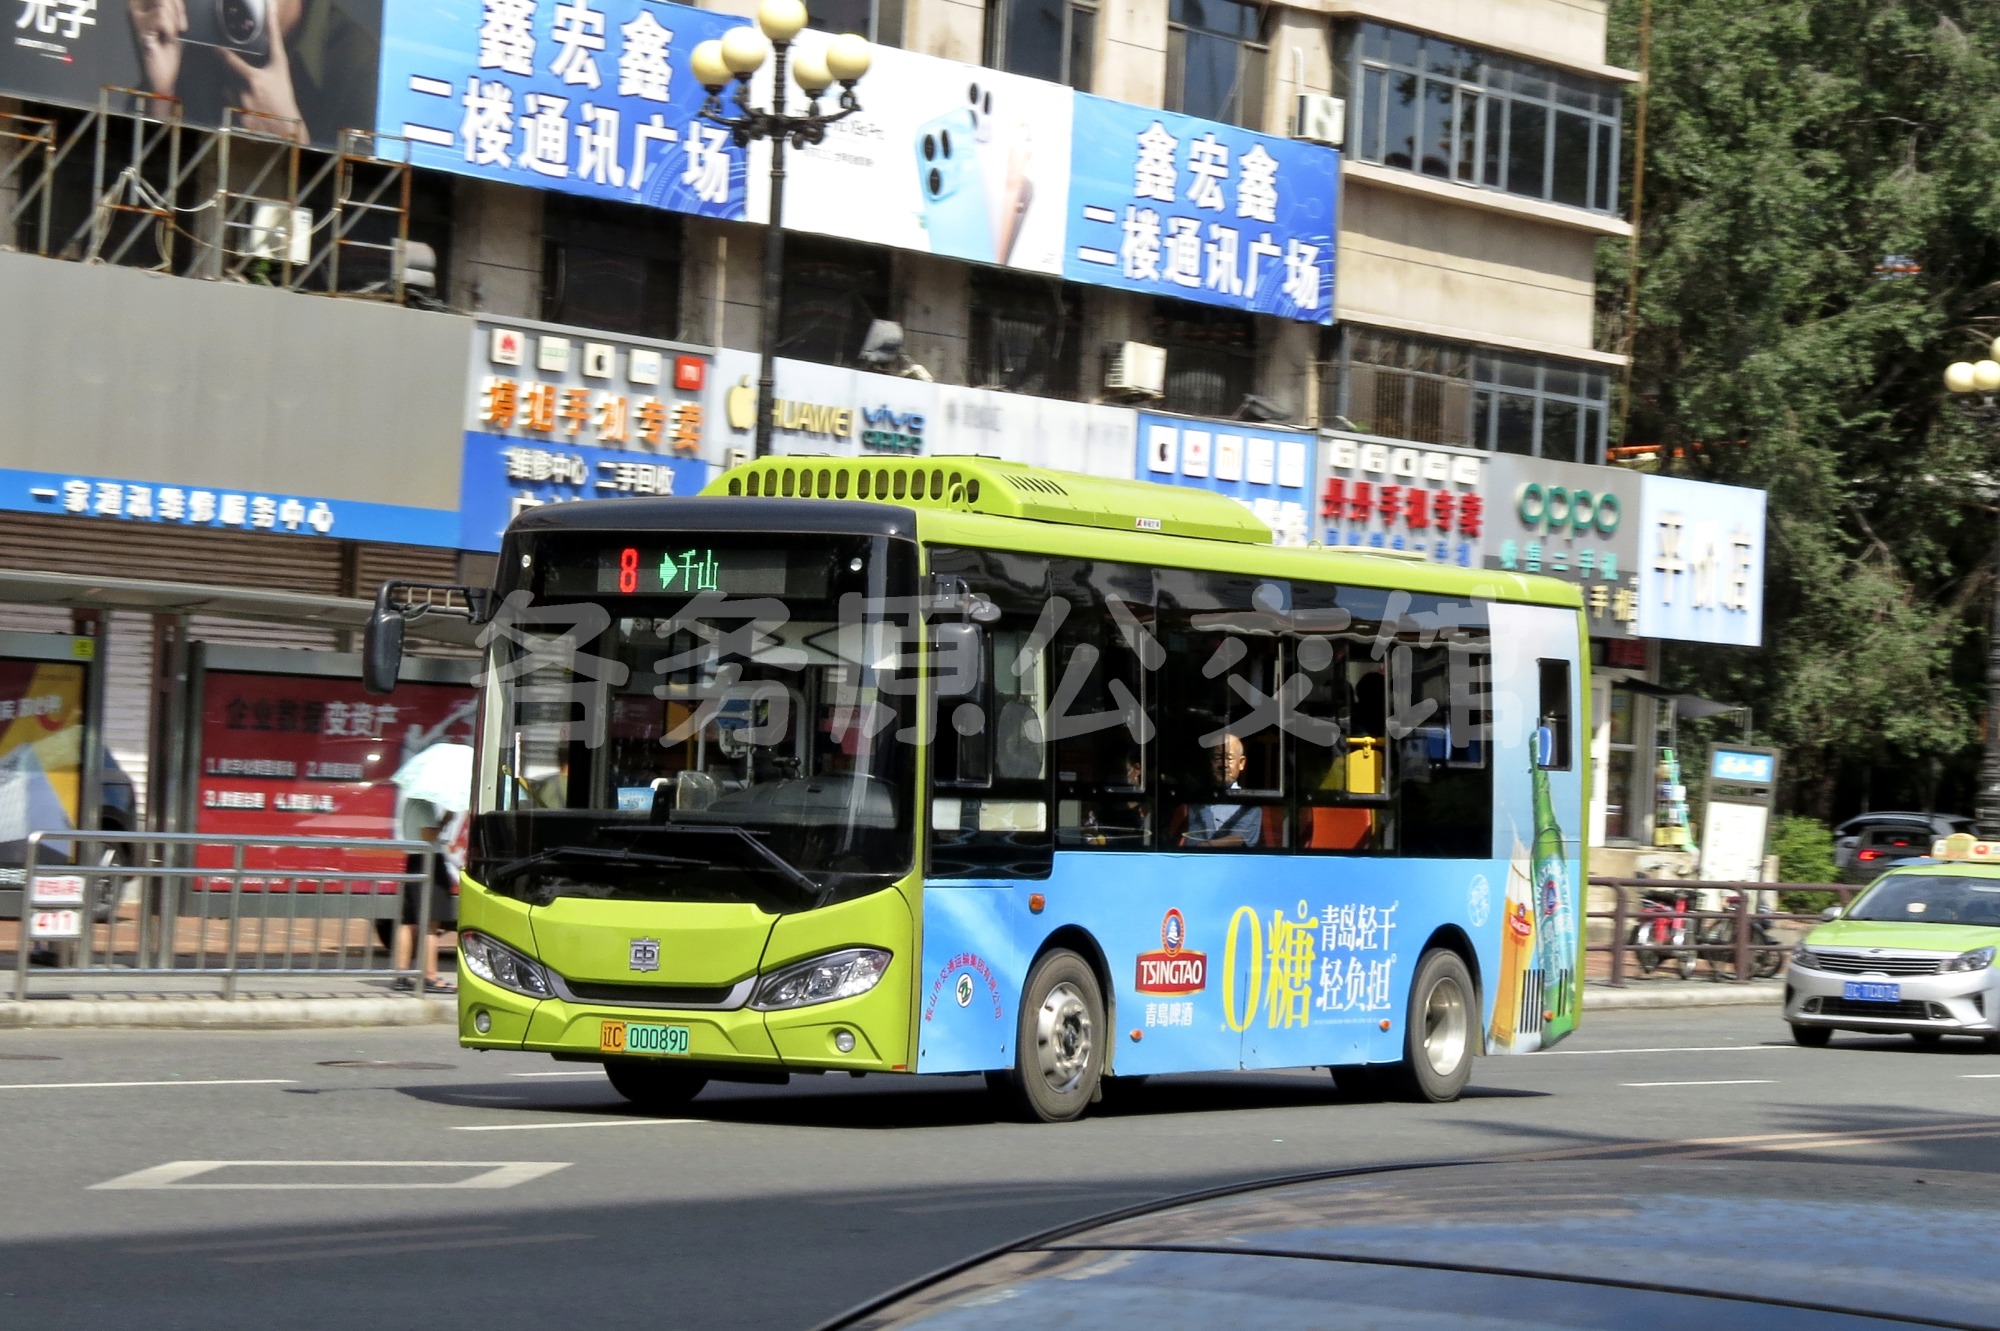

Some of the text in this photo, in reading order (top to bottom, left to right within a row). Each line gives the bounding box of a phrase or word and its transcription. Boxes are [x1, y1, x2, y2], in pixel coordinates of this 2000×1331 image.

[478, 0, 674, 103] 鑫宏鑫
[403, 74, 731, 204] 二楼通讯广场
[1133, 120, 1279, 224] 鑫宏鑫
[1077, 203, 1320, 311] 二楼通讯广场
[595, 460, 676, 496] 二手回收
[619, 548, 719, 593] 8 千山
[1140, 959, 1203, 986] TSINGTAO
[1316, 955, 1397, 1012] 轻负担
